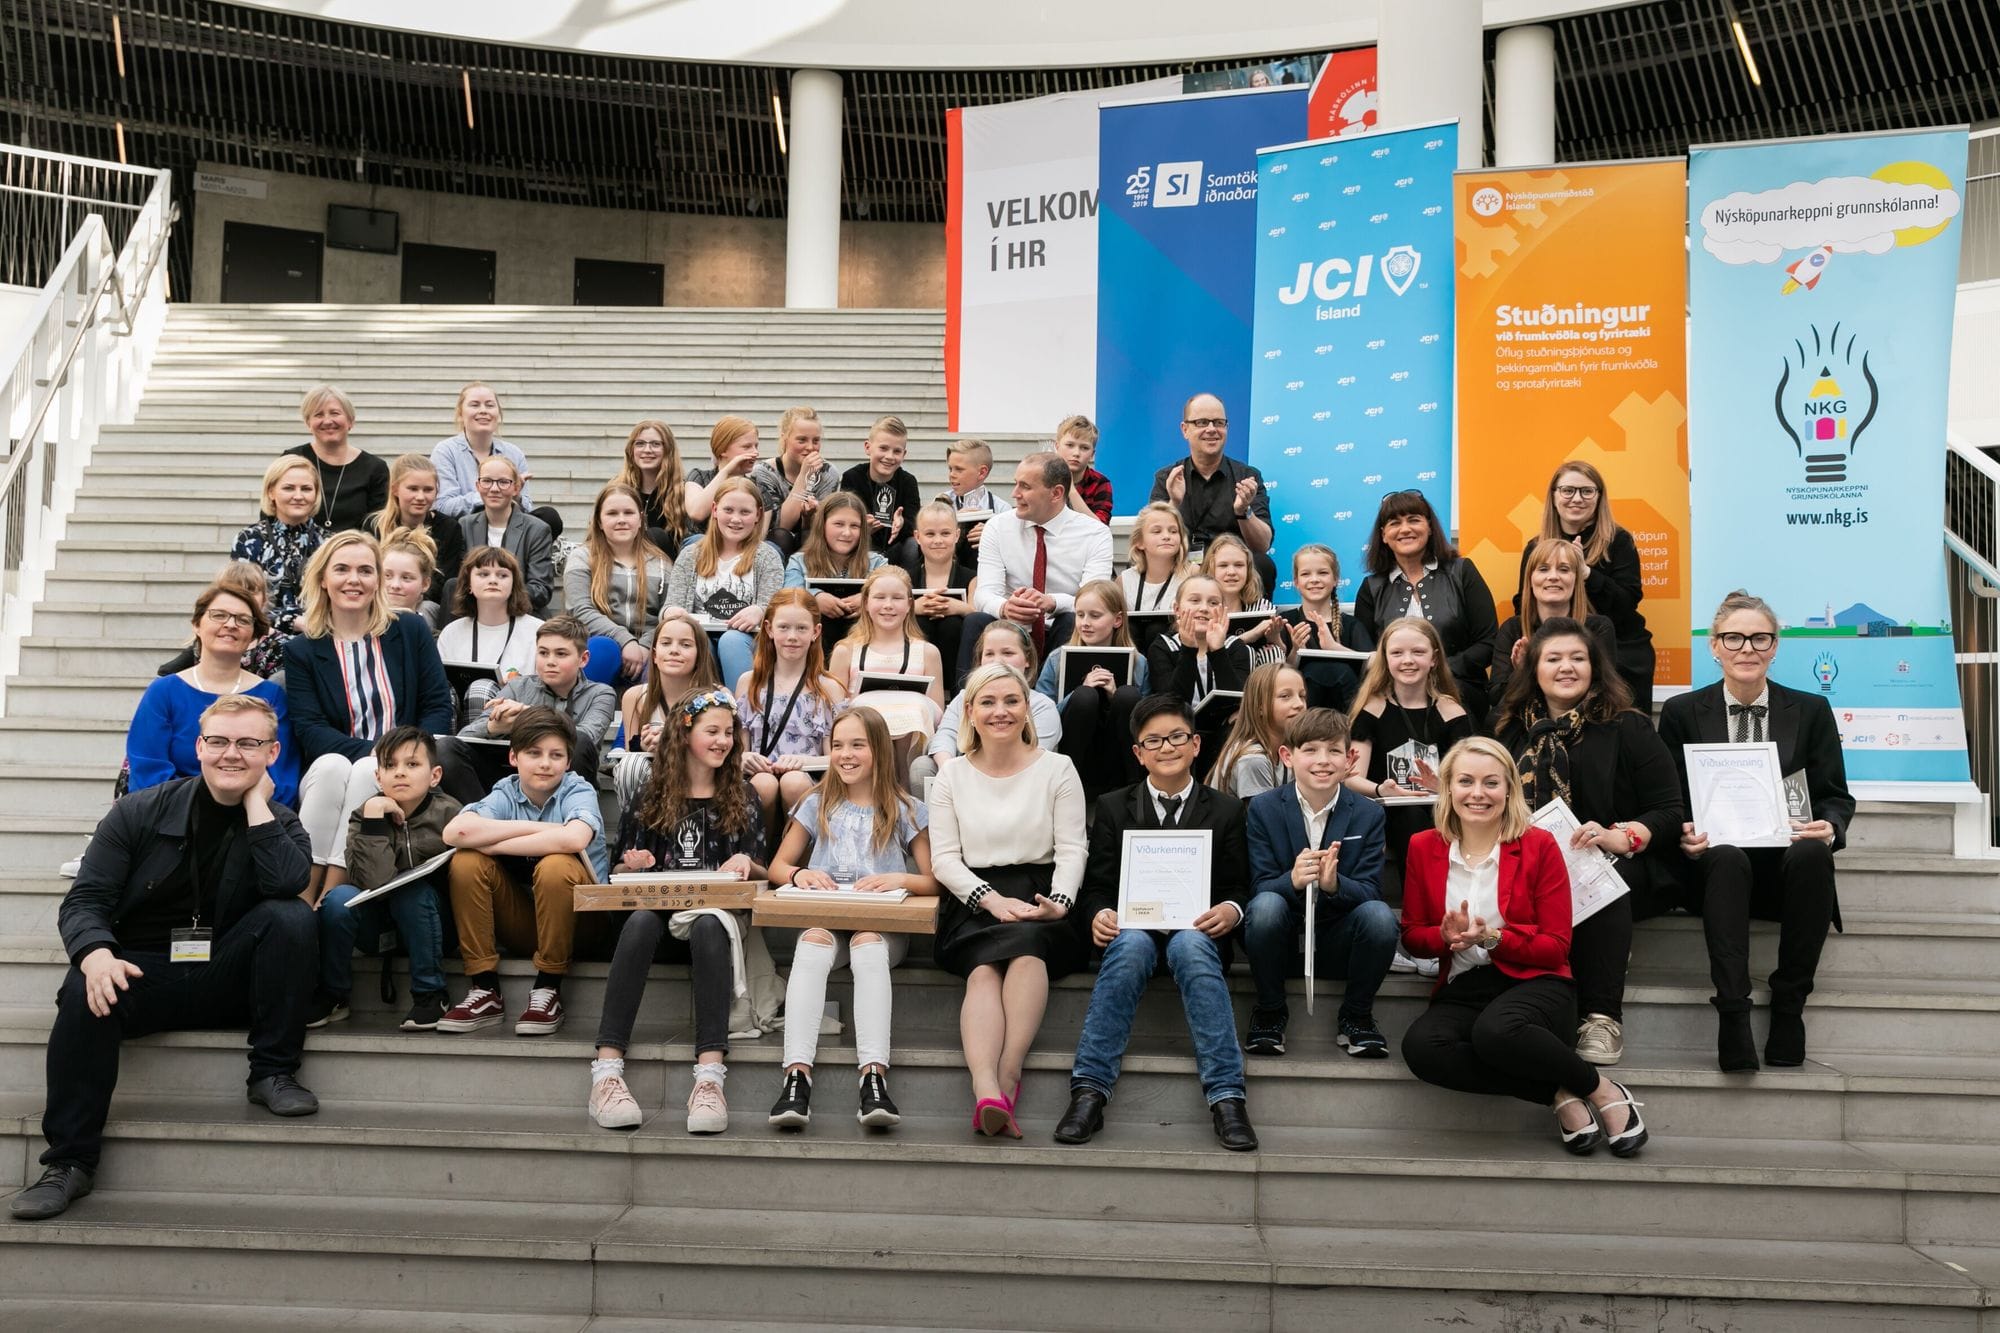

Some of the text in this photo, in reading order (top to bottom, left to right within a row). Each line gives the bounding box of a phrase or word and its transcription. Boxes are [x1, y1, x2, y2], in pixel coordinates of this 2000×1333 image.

[1126, 166, 1150, 195] 25
[1166, 174, 1189, 196] SI
[1207, 171, 1258, 188] Samtök
[987, 188, 1100, 229] VELKOM
[1715, 194, 1939, 226] Nýsköpunarkeppni grunnskólanna!
[991, 236, 1045, 271] Í HR
[1278, 255, 1374, 305] JCI
[1316, 304, 1361, 321] Ísland
[1496, 303, 1651, 329] Stuðningur
[1496, 327, 1651, 342] við frumkvöðla og fyrirtæki
[1496, 347, 1524, 360] Öflug
[1617, 346, 1633, 356] og
[1496, 381, 1511, 391] og
[1805, 400, 1847, 416] NKG
[1787, 507, 1868, 528] www.nkg.is
[1633, 530, 1668, 542] köpun
[1638, 546, 1668, 557] nerpa
[1641, 575, 1668, 586] uður
[1852, 735, 1868, 743] JCI
[1136, 846, 1197, 855] Viðurkenning
